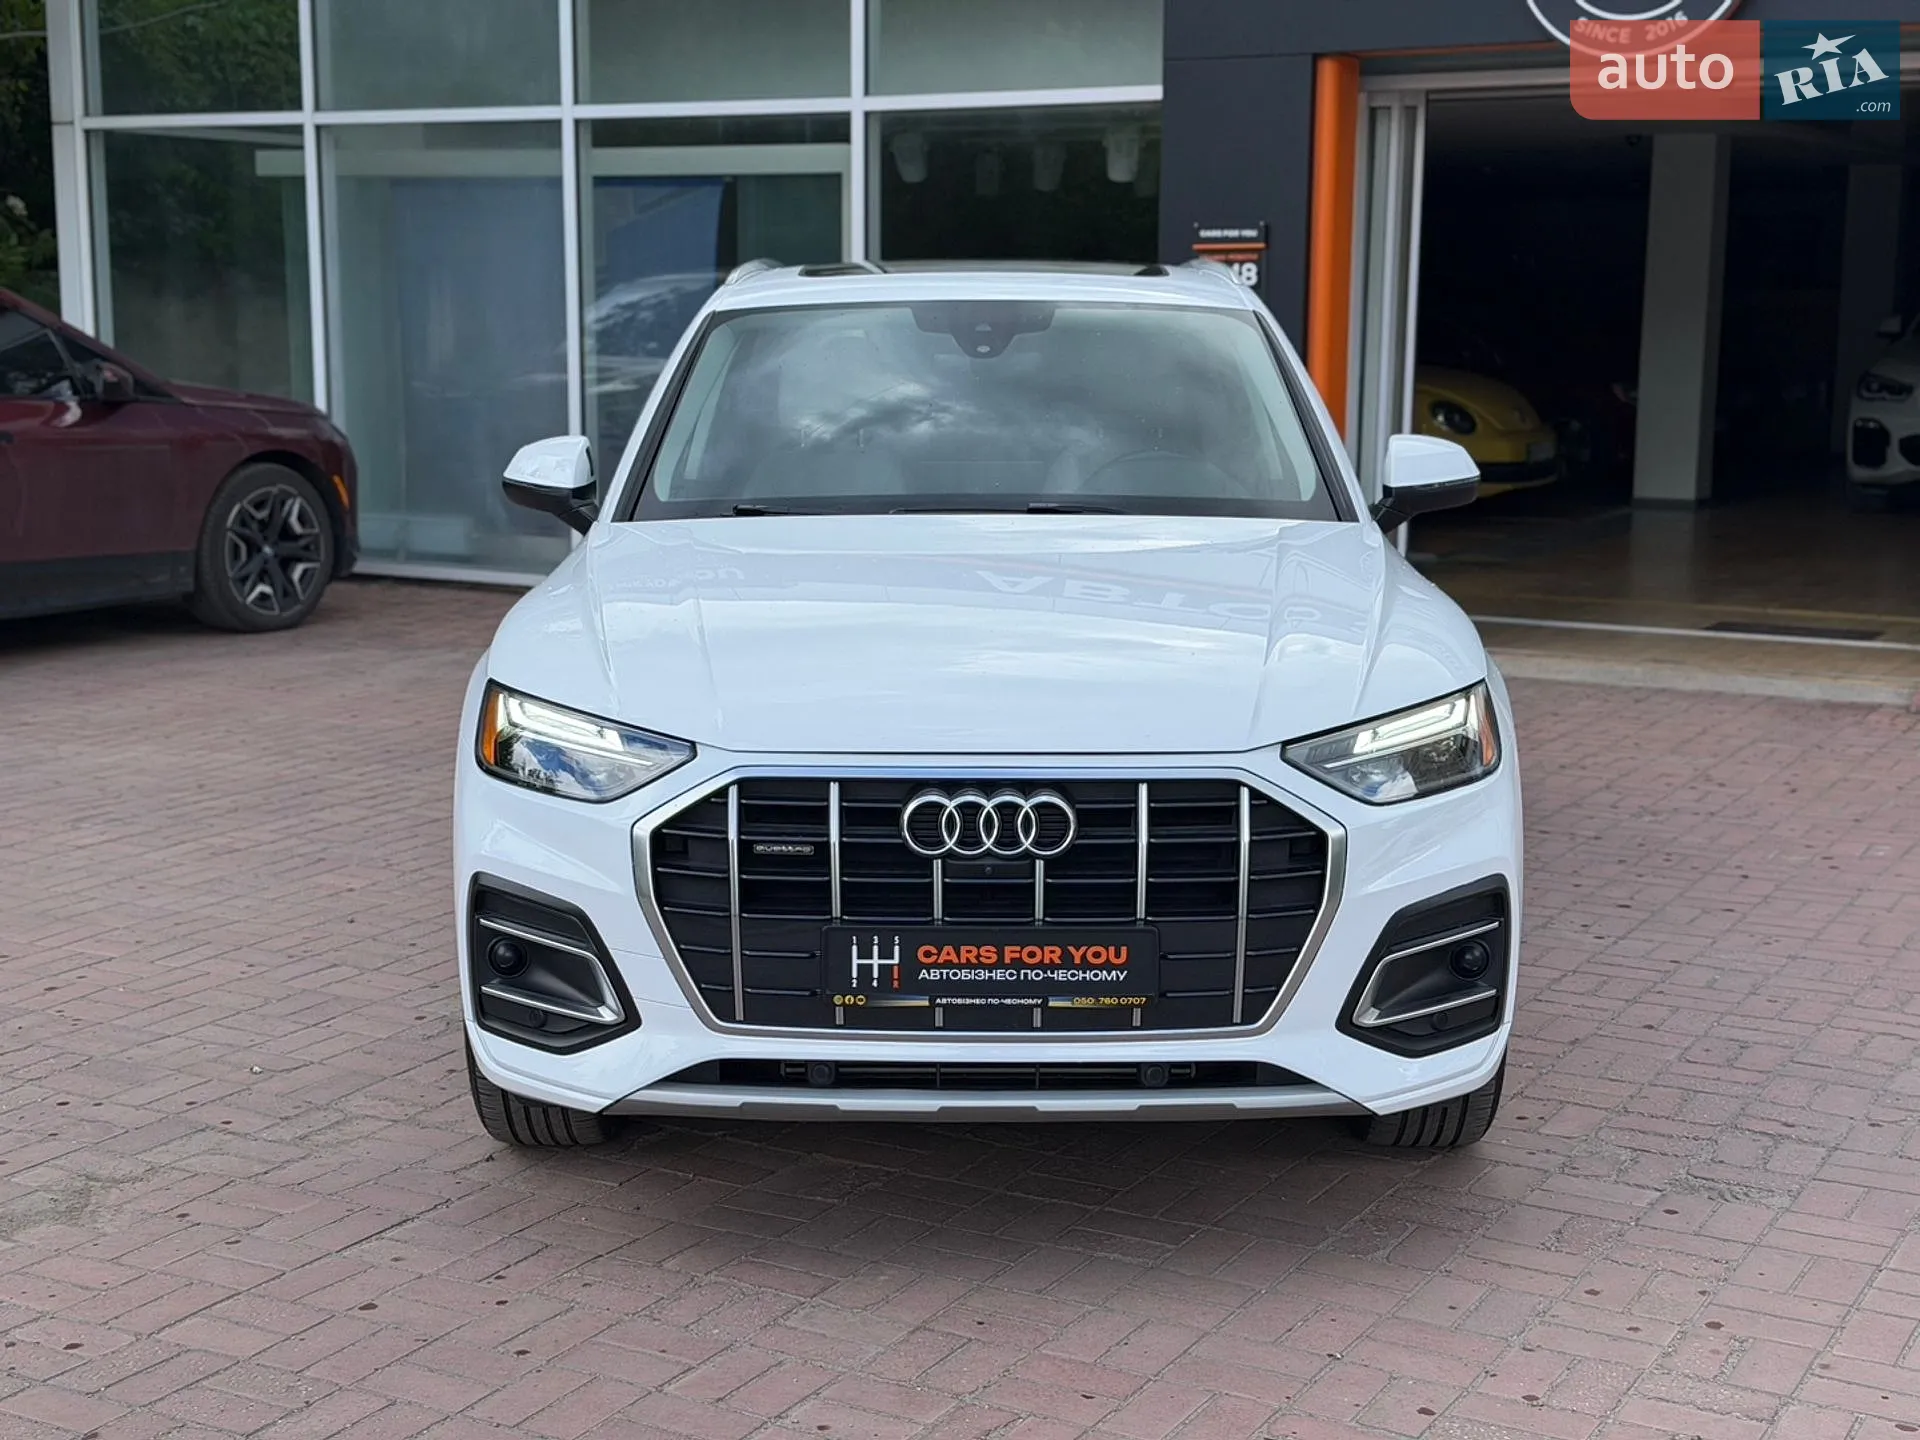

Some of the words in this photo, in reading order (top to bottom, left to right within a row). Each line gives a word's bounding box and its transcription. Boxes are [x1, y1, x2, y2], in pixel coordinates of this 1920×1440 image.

[1574, 16, 1632, 44] SINCE
[1644, 10, 1689, 42] 2016
[916, 944, 998, 965] CARS
[1003, 945, 1063, 965] FOR
[1066, 945, 1129, 965] YOU
[918, 968, 1018, 982] АВТОБІЗНЕС
[1119, 997, 1147, 1005] 0707
